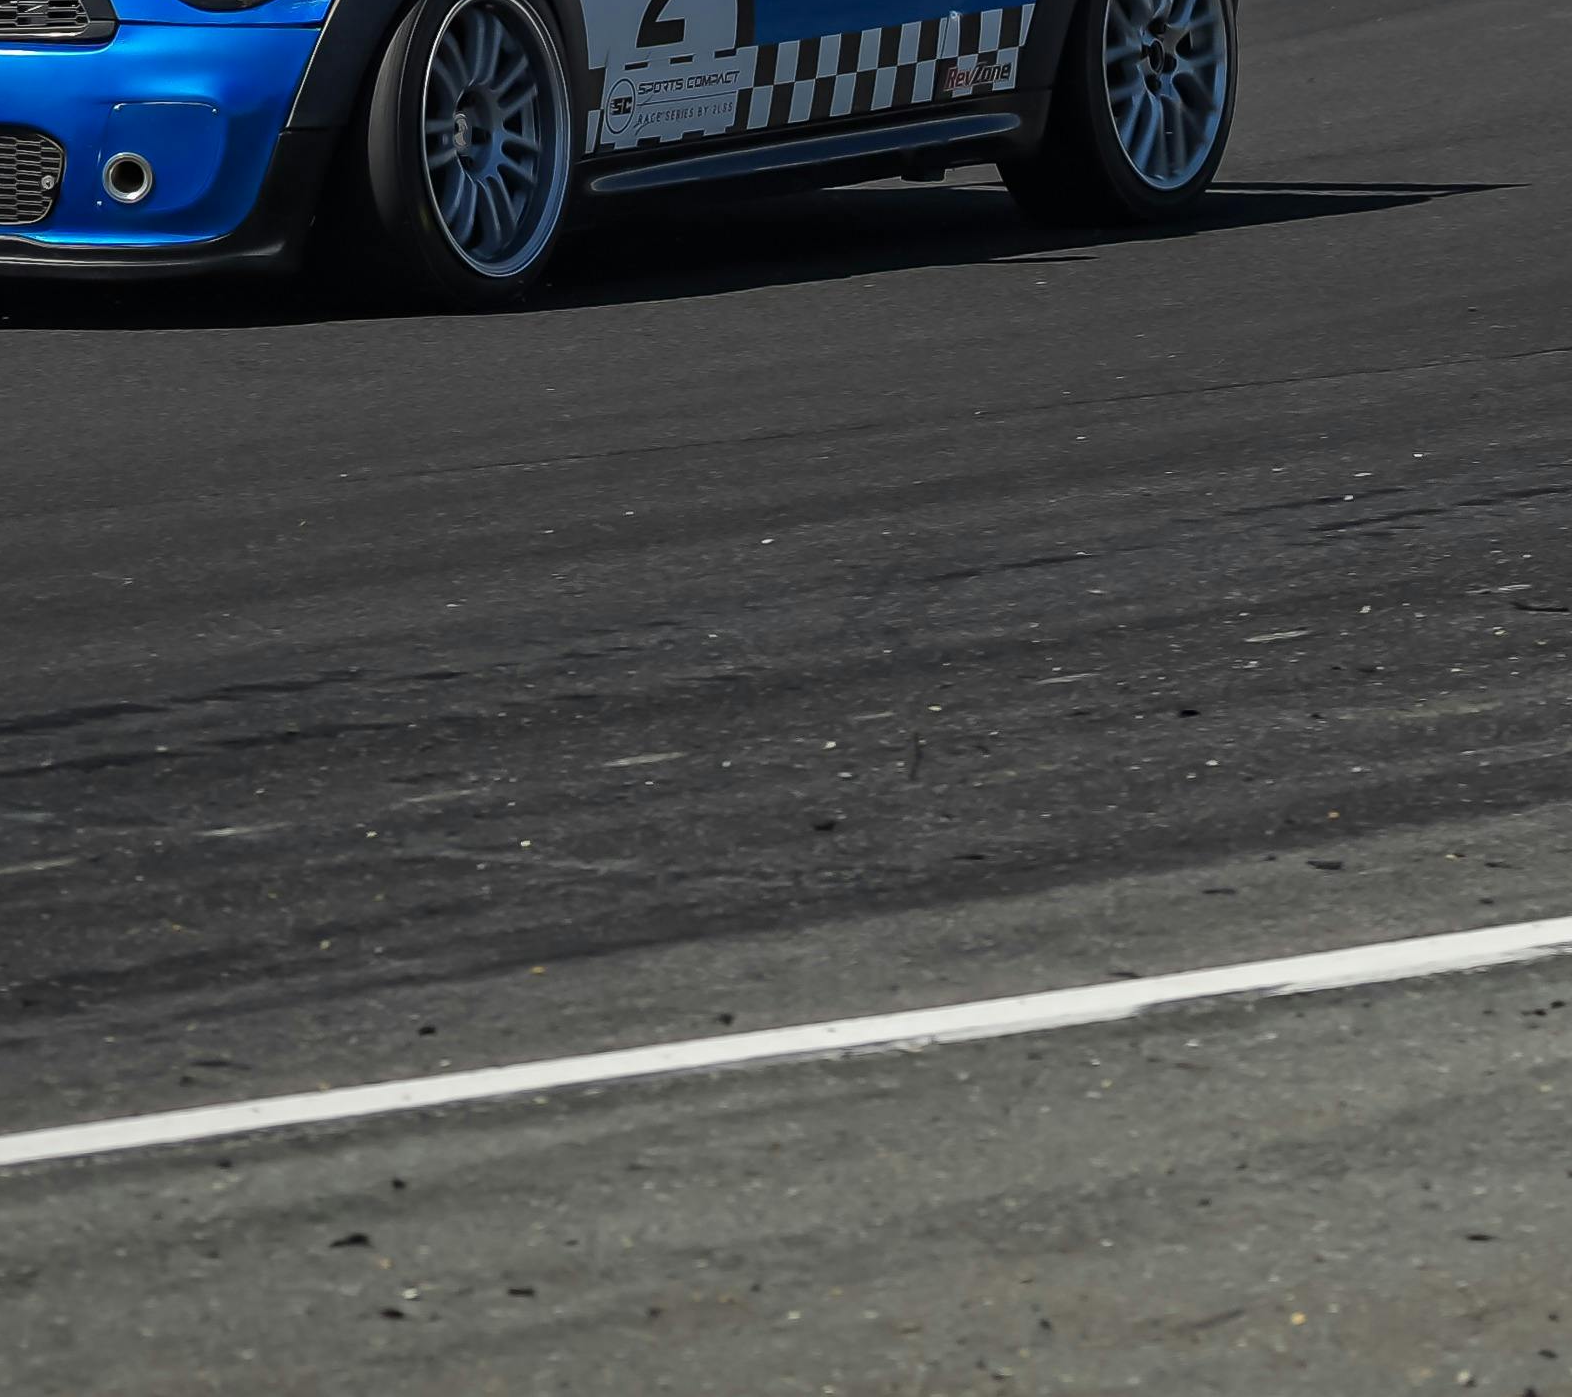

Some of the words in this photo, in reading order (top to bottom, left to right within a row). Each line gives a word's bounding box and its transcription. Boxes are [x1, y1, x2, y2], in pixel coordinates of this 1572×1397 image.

[637, 78, 684, 95] SPORTS
[686, 71, 740, 89] COMPACT
[944, 62, 1012, 88] RevZone
[637, 112, 662, 124] RACE
[665, 107, 694, 120] SERIES
[697, 106, 708, 116] BY
